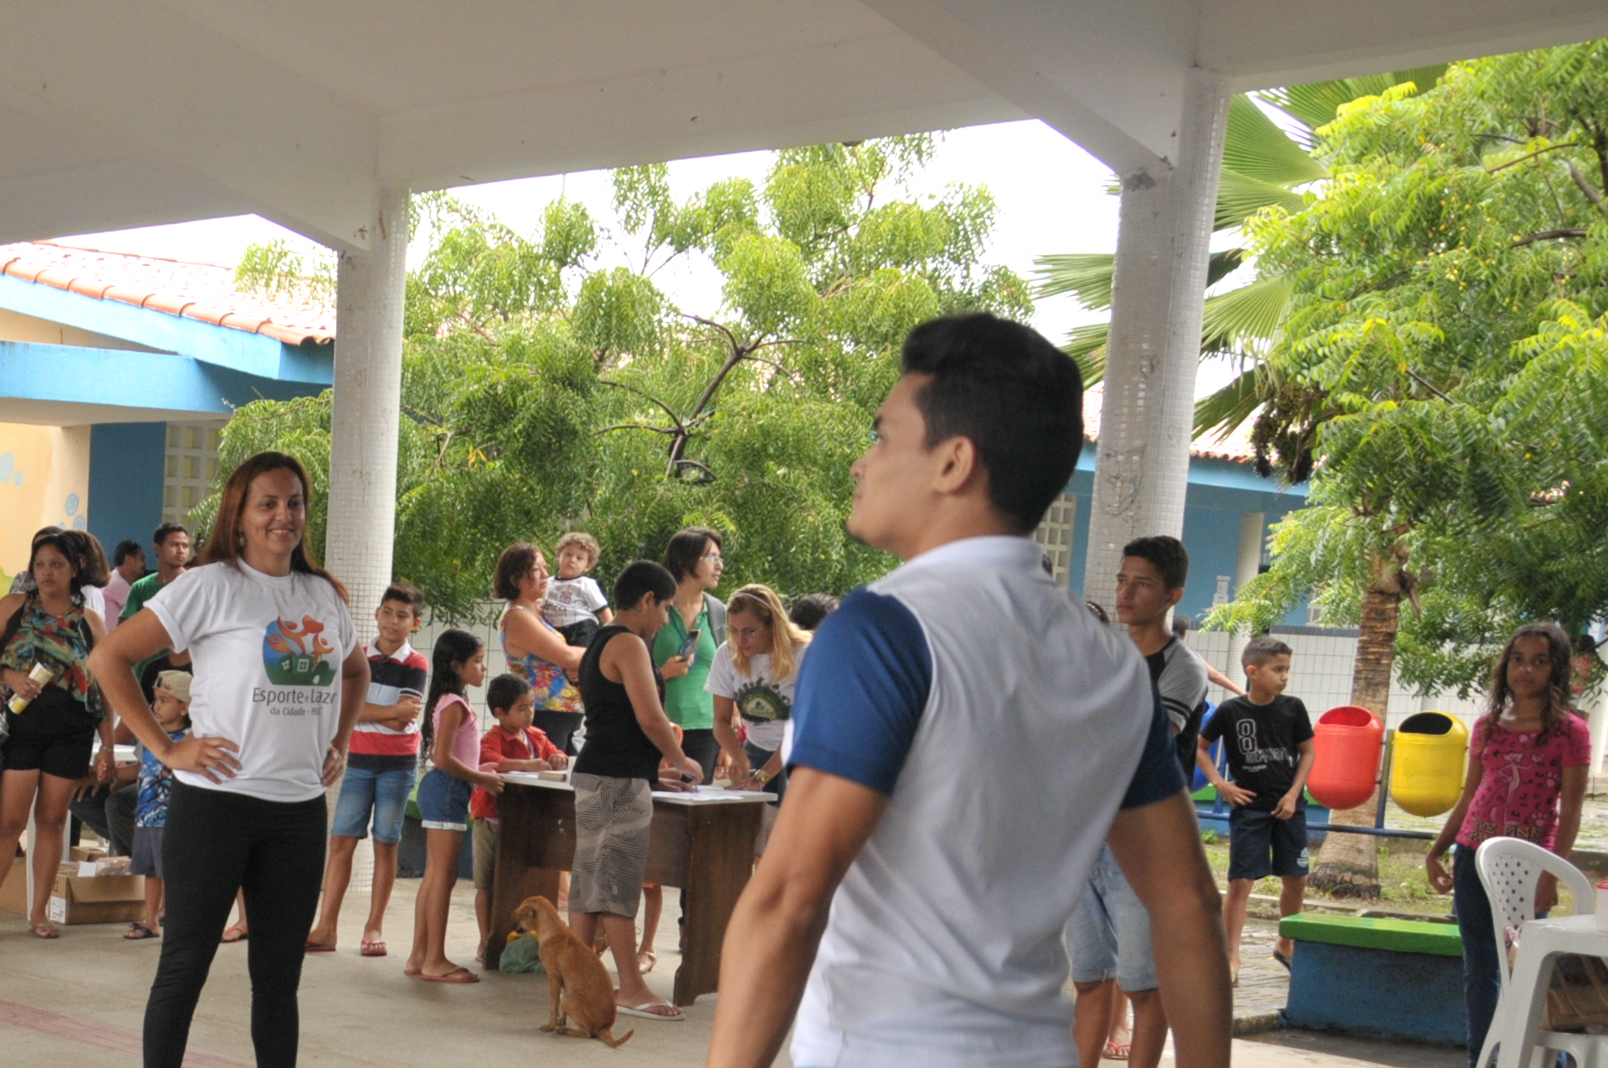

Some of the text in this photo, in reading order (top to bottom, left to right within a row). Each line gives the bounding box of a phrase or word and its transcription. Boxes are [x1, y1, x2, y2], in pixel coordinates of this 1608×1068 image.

[253, 688, 338, 706] Esporte e Lazr
[270, 706, 281, 716] da
[282, 707, 306, 716] Cidade
